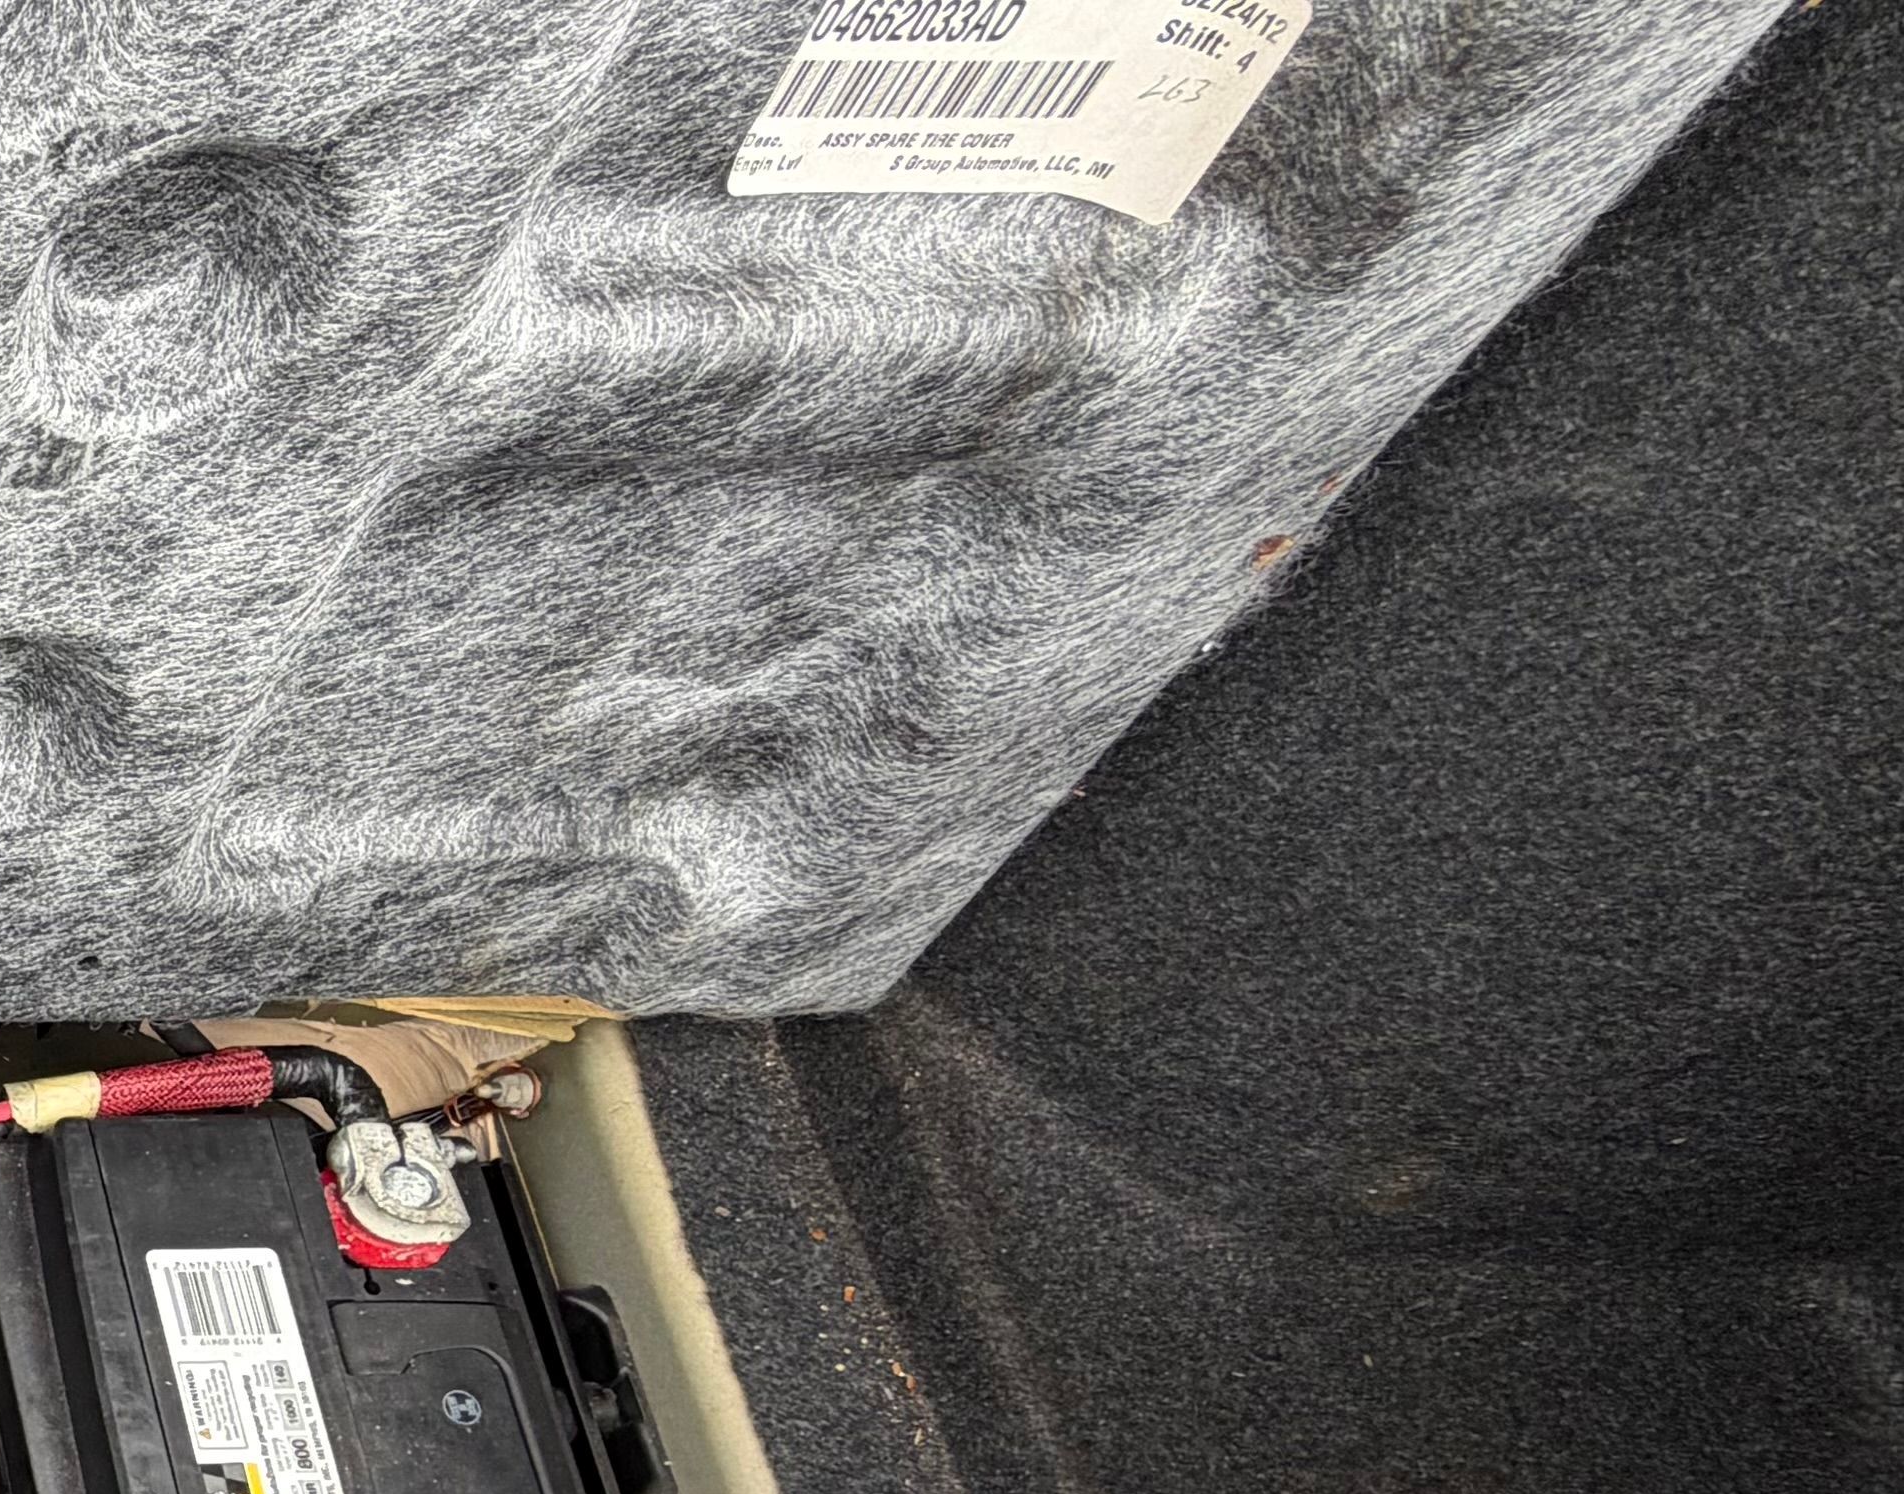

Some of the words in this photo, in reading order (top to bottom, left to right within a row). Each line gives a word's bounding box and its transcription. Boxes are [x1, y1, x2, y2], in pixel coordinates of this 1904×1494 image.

[811, 0, 1027, 42] 04662033AD
[1156, 19, 1231, 60] Shift:
[1236, 50, 1258, 74] 4
[743, 133, 783, 148] Desc.
[818, 133, 865, 148] ASSY
[866, 133, 920, 148] SPARE
[920, 133, 960, 148] TIRE
[960, 133, 1014, 148] COVER
[904, 155, 952, 175] Group
[953, 156, 1040, 173] Automotive,
[1044, 156, 1081, 176] LLC,
[282, 1398, 299, 1423] 1000
[290, 1438, 313, 1469] 800
